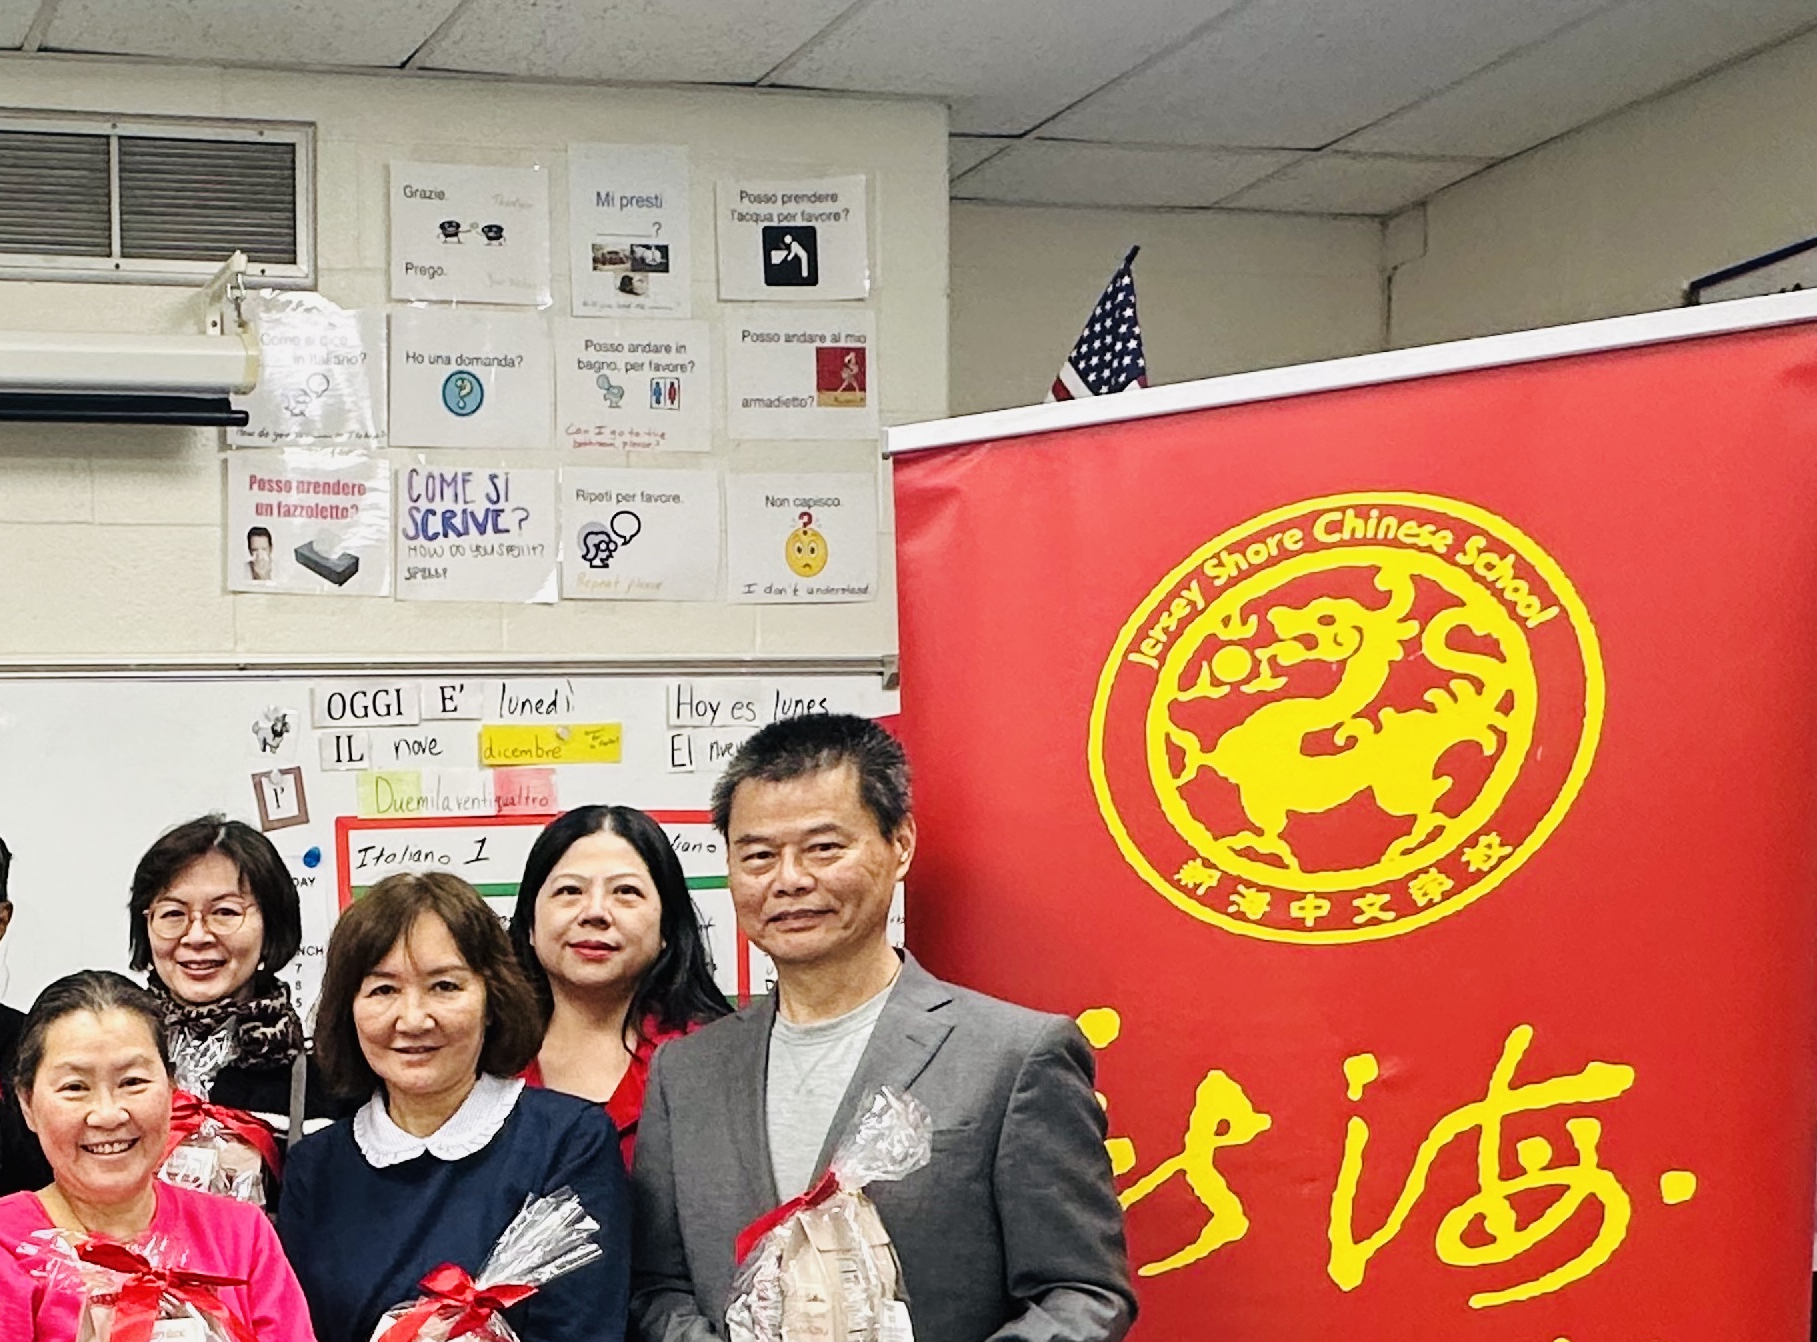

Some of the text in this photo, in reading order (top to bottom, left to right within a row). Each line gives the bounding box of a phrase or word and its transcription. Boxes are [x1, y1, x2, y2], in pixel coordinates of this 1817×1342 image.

[596, 191, 663, 211] Mi presti
[739, 190, 838, 206] Posso prendere
[778, 210, 797, 225] per
[801, 208, 850, 223] favore?
[741, 330, 867, 344] Posso andare al mio
[584, 340, 687, 354] Posso andare in
[406, 351, 524, 368] Ho una domanda?
[625, 360, 645, 374] per
[648, 359, 696, 374] favore?
[741, 395, 815, 408] armadietto?
[249, 474, 366, 497] Posso prendere
[408, 468, 510, 505] COME SI
[616, 491, 637, 504] per
[765, 495, 790, 508] Non
[255, 501, 359, 521] un fazzoletto?
[1128, 508, 1559, 669] Jersey Shore Chinese School
[327, 688, 404, 720] OGGI
[676, 684, 829, 726] Hoy es lunes
[335, 735, 364, 764] IL
[393, 736, 443, 757] nove
[483, 737, 563, 761] dicembre
[671, 733, 693, 767] El
[356, 843, 451, 869] Italiano
[295, 963, 303, 974] 7
